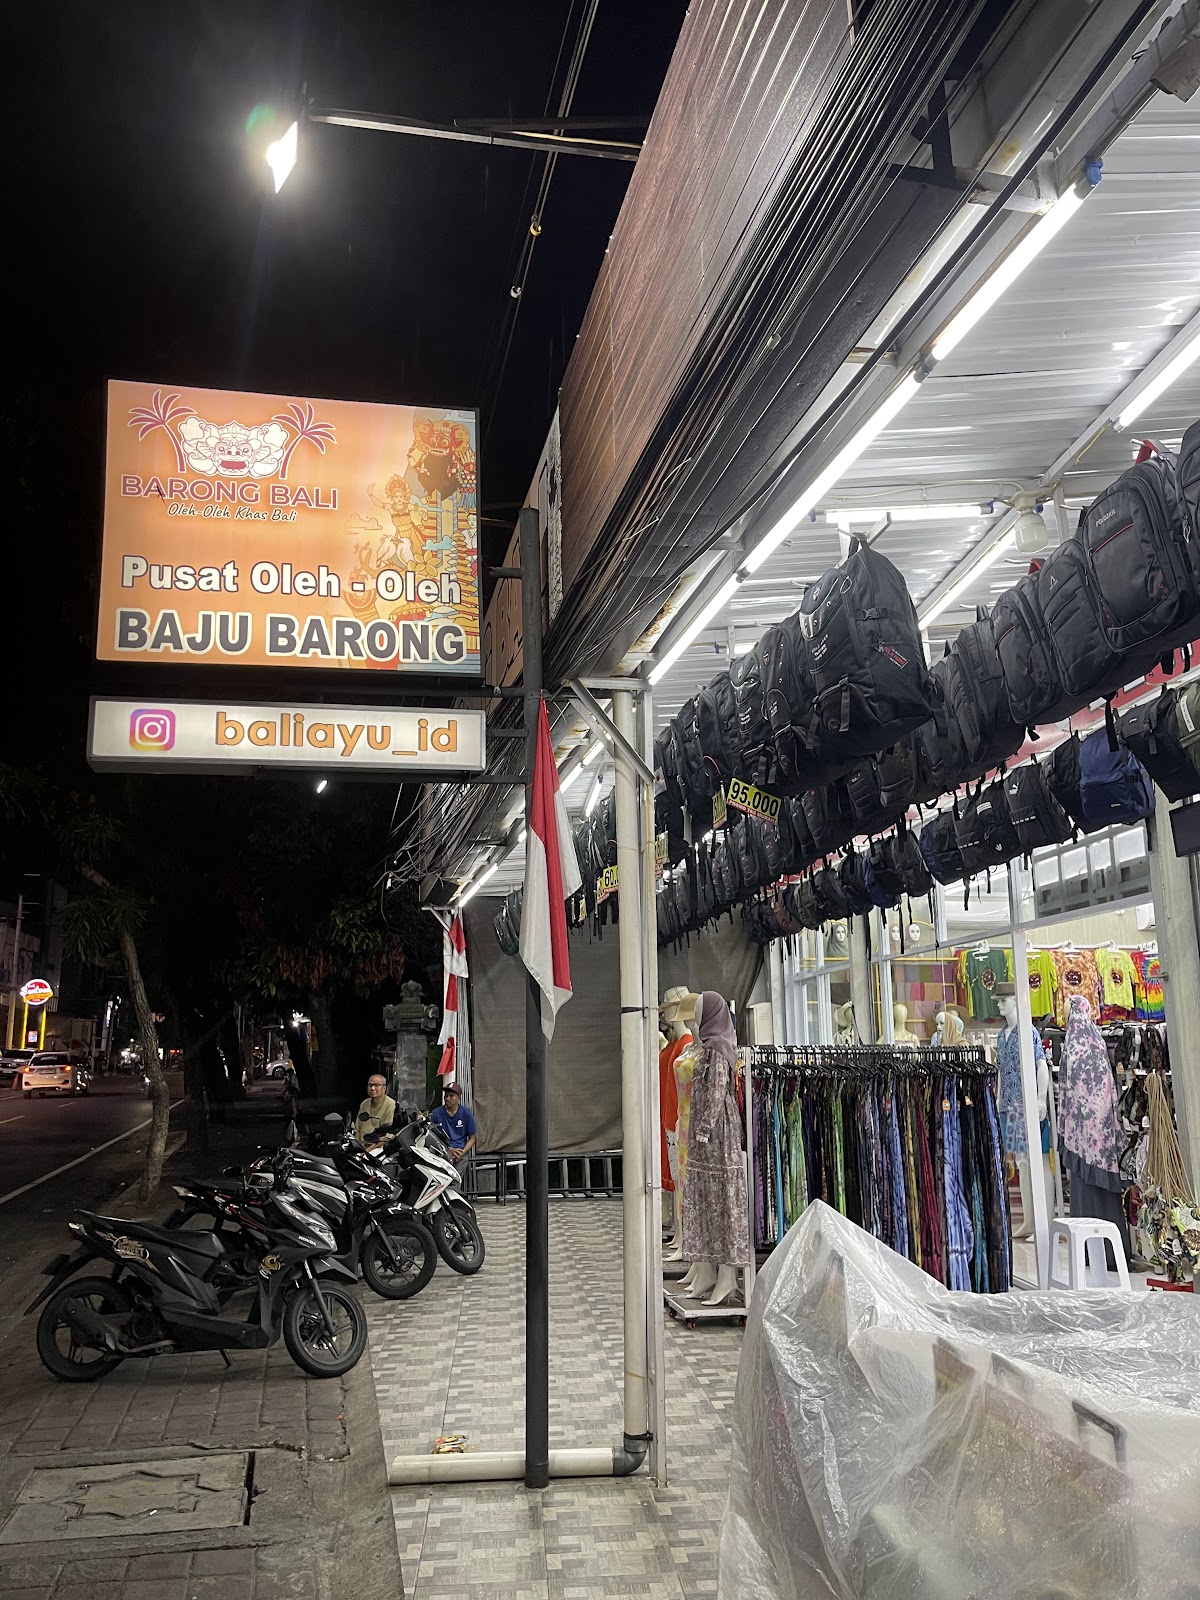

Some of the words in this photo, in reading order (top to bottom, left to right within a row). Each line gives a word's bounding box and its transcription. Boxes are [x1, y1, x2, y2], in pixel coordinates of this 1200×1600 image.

[121, 474, 260, 504] BARONG
[270, 484, 339, 510] BALI
[235, 506, 268, 521] Khas
[271, 508, 298, 522] Bali
[121, 555, 239, 593] Pusat
[250, 561, 341, 598] Oleh
[376, 568, 462, 604] Oleh
[115, 608, 252, 655] BAJU
[266, 614, 466, 664] BARONG
[215, 711, 458, 757] baliayu_id
[731, 781, 779, 817] 95.000
